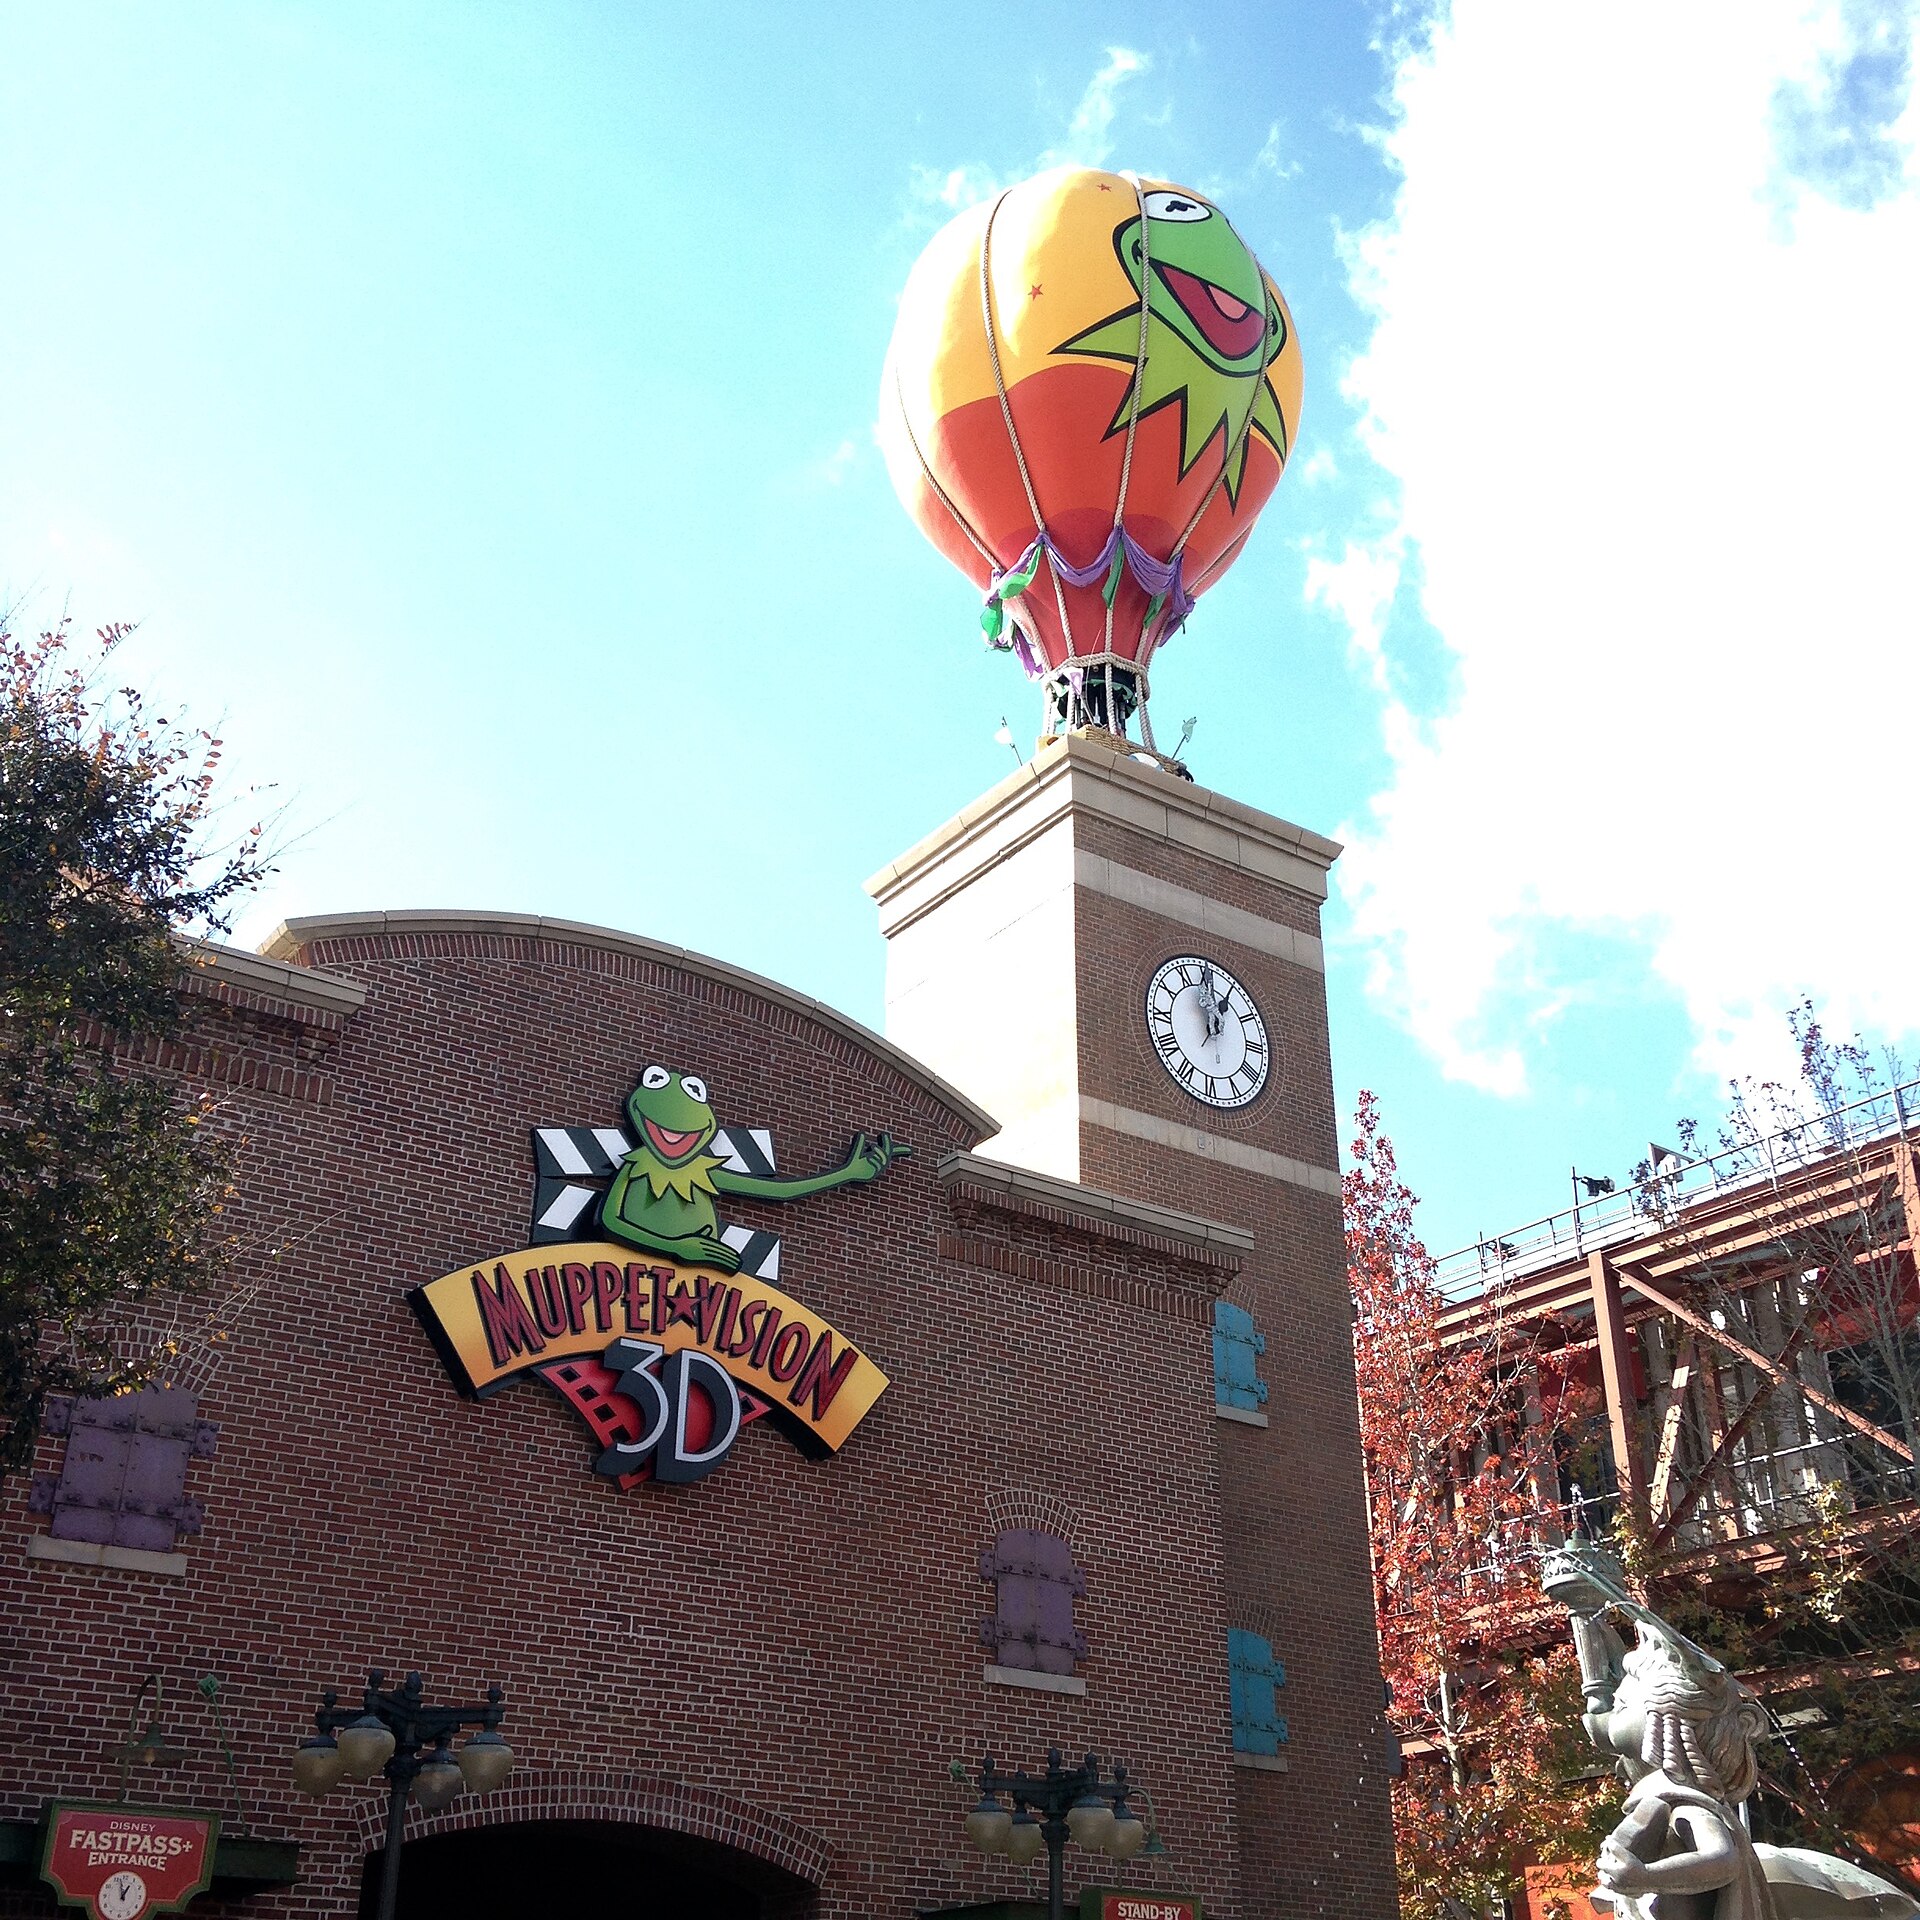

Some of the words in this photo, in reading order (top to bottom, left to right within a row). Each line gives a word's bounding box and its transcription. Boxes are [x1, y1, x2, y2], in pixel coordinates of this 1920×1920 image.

[472, 1261, 675, 1368] MUPPET
[695, 1275, 859, 1422] VISION
[612, 1337, 742, 1466] 3D
[110, 1821, 156, 1832] DISNEY
[69, 1829, 193, 1856] FASTPASS+
[88, 1851, 168, 1871] ENTRANCE
[1117, 1901, 1181, 1920] STAND-BY
